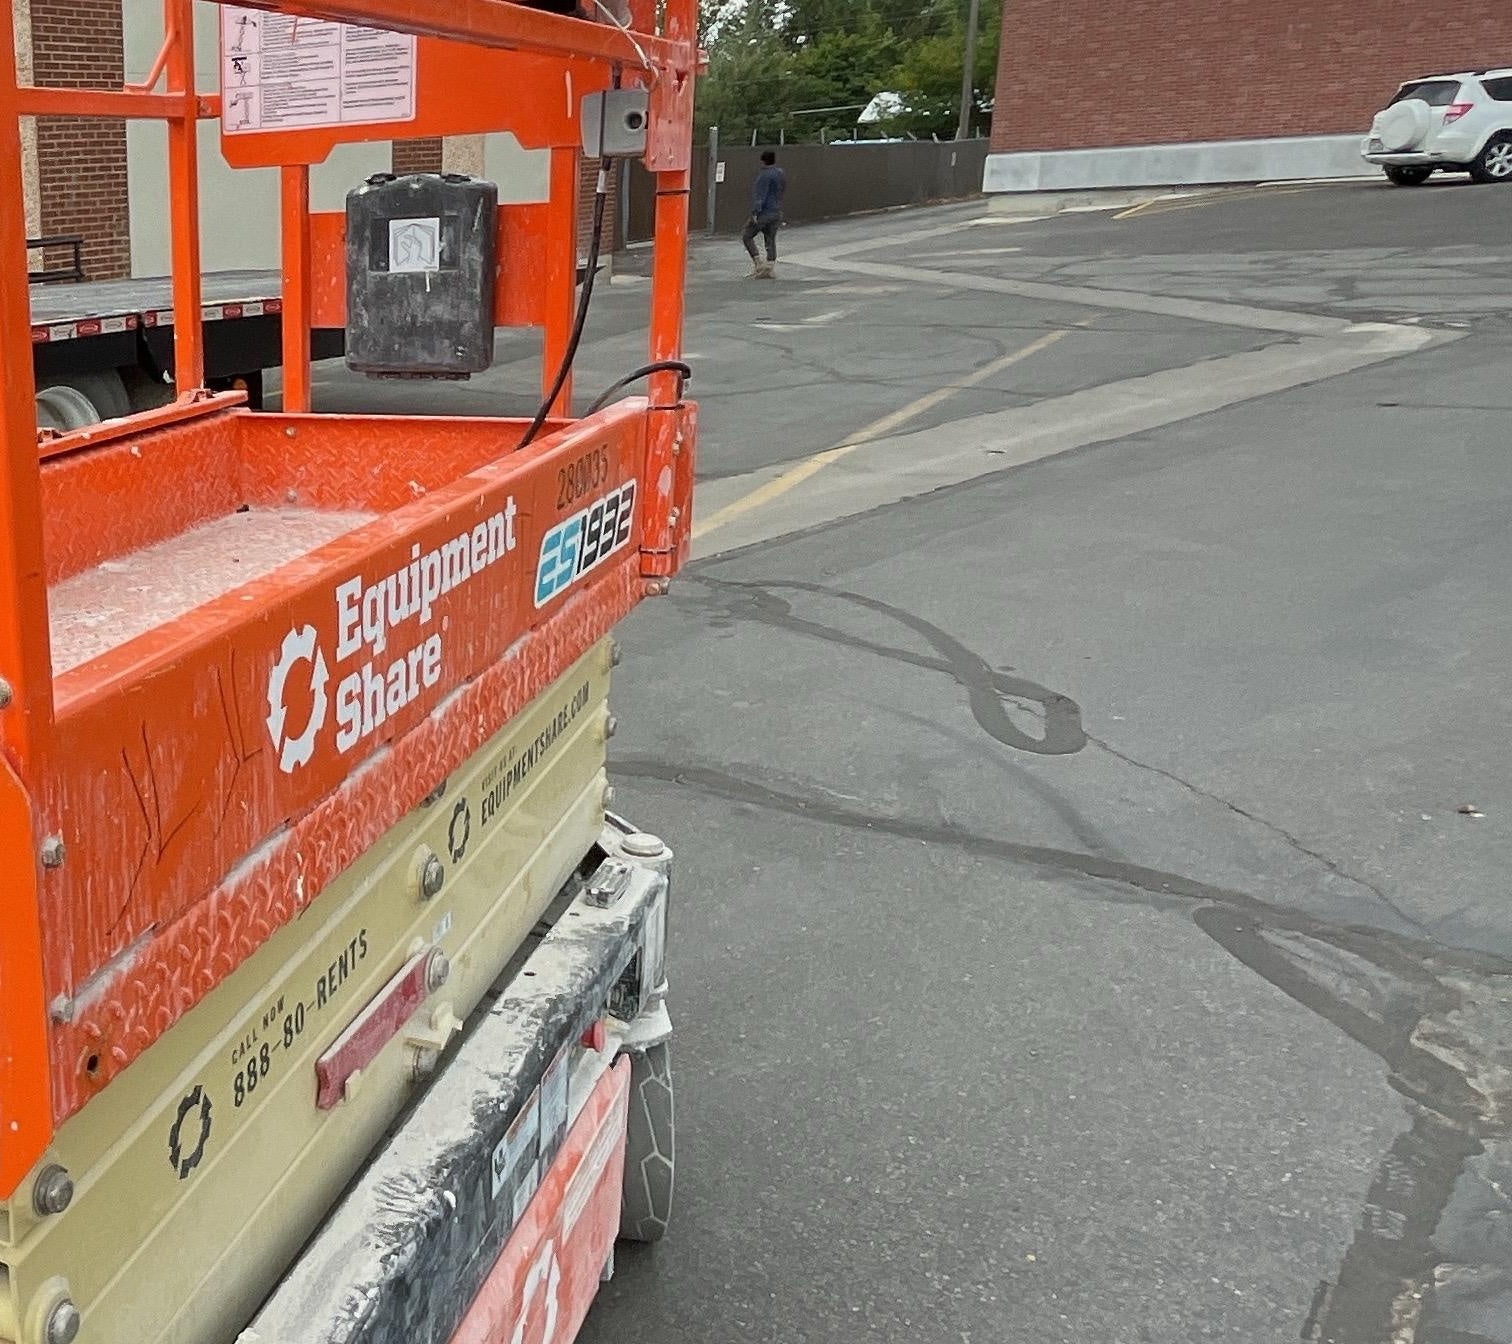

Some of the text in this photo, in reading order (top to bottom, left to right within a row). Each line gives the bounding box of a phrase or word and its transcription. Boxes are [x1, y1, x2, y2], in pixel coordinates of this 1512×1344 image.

[336, 495, 518, 663] Equipment
[536, 482, 637, 604] ES1932
[336, 632, 443, 755] Share
[481, 681, 590, 827] EQUIPMENTSHARE.COM
[233, 928, 368, 1108] 888-80-RENTS
[233, 994, 285, 1064] CALL NOW
